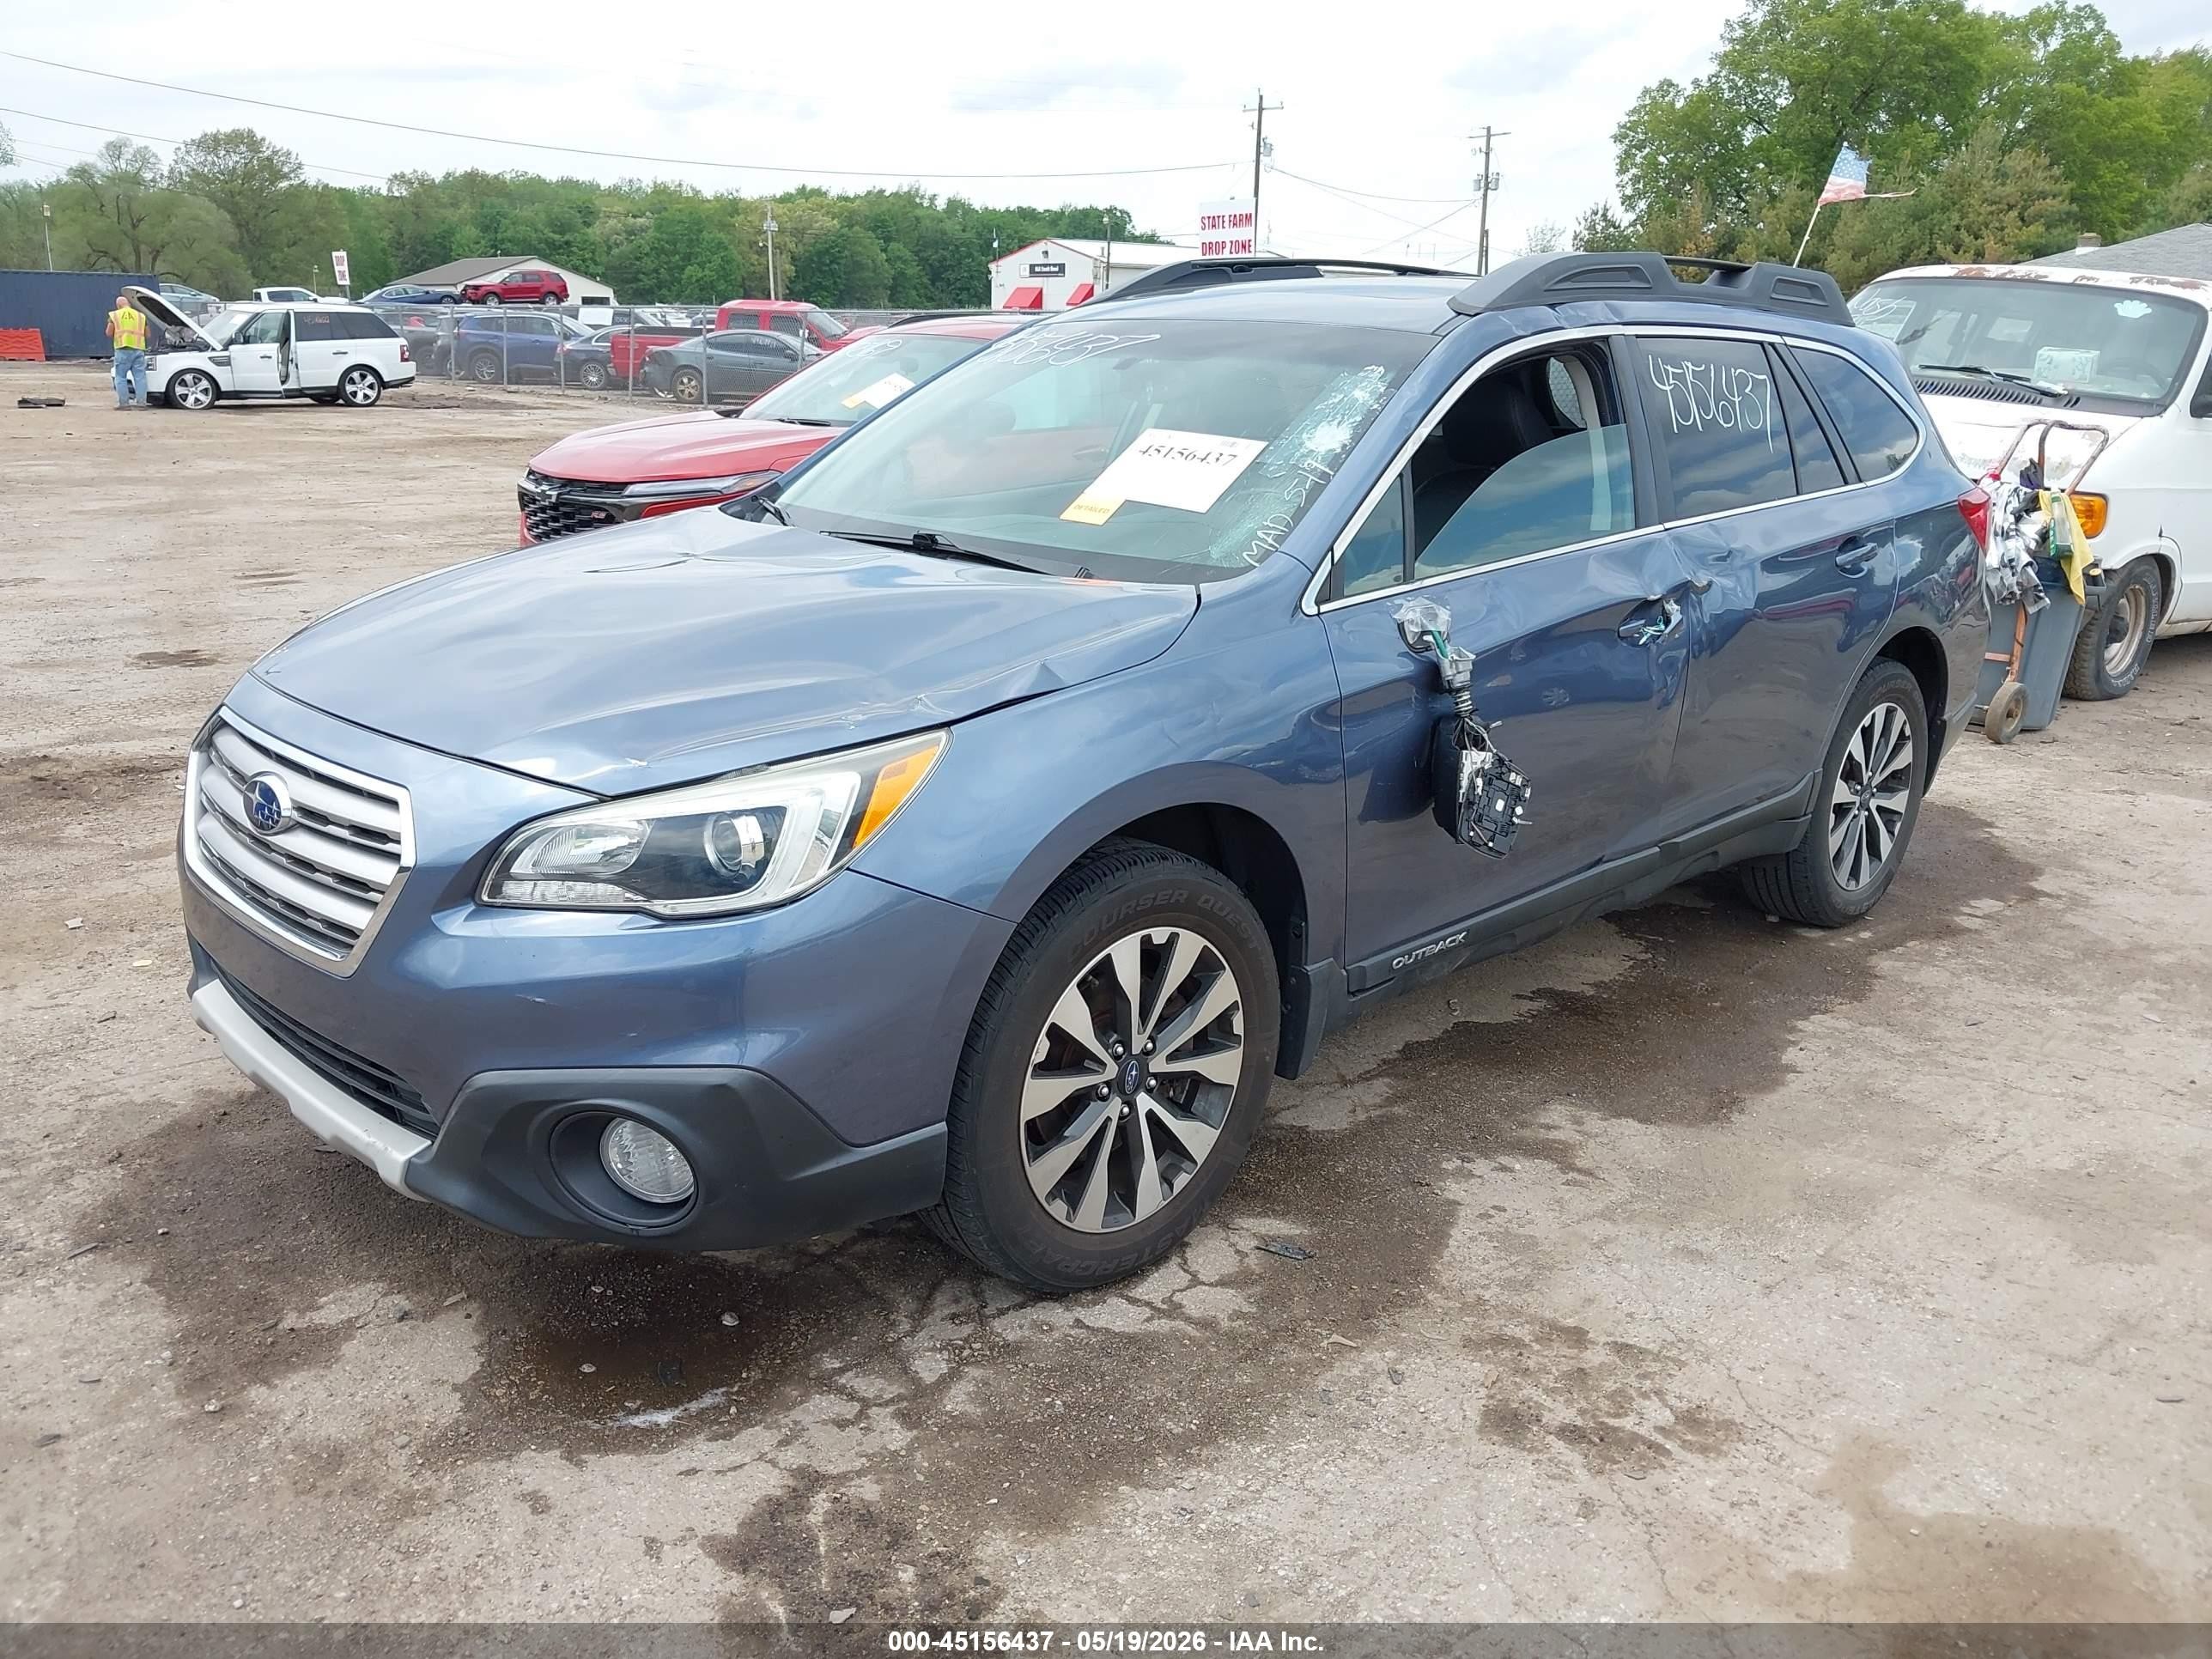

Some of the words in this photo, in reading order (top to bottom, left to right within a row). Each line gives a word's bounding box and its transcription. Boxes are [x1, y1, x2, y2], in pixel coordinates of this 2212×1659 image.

[1200, 215, 1226, 231] STATE
[1228, 212, 1253, 229] FARM
[1201, 240, 1226, 257] DROP
[1229, 239, 1253, 255] ZONE
[1648, 355, 1773, 453] 45156437
[1139, 444, 1238, 466] 45156437
[1392, 931, 1468, 969] OUTBACK
